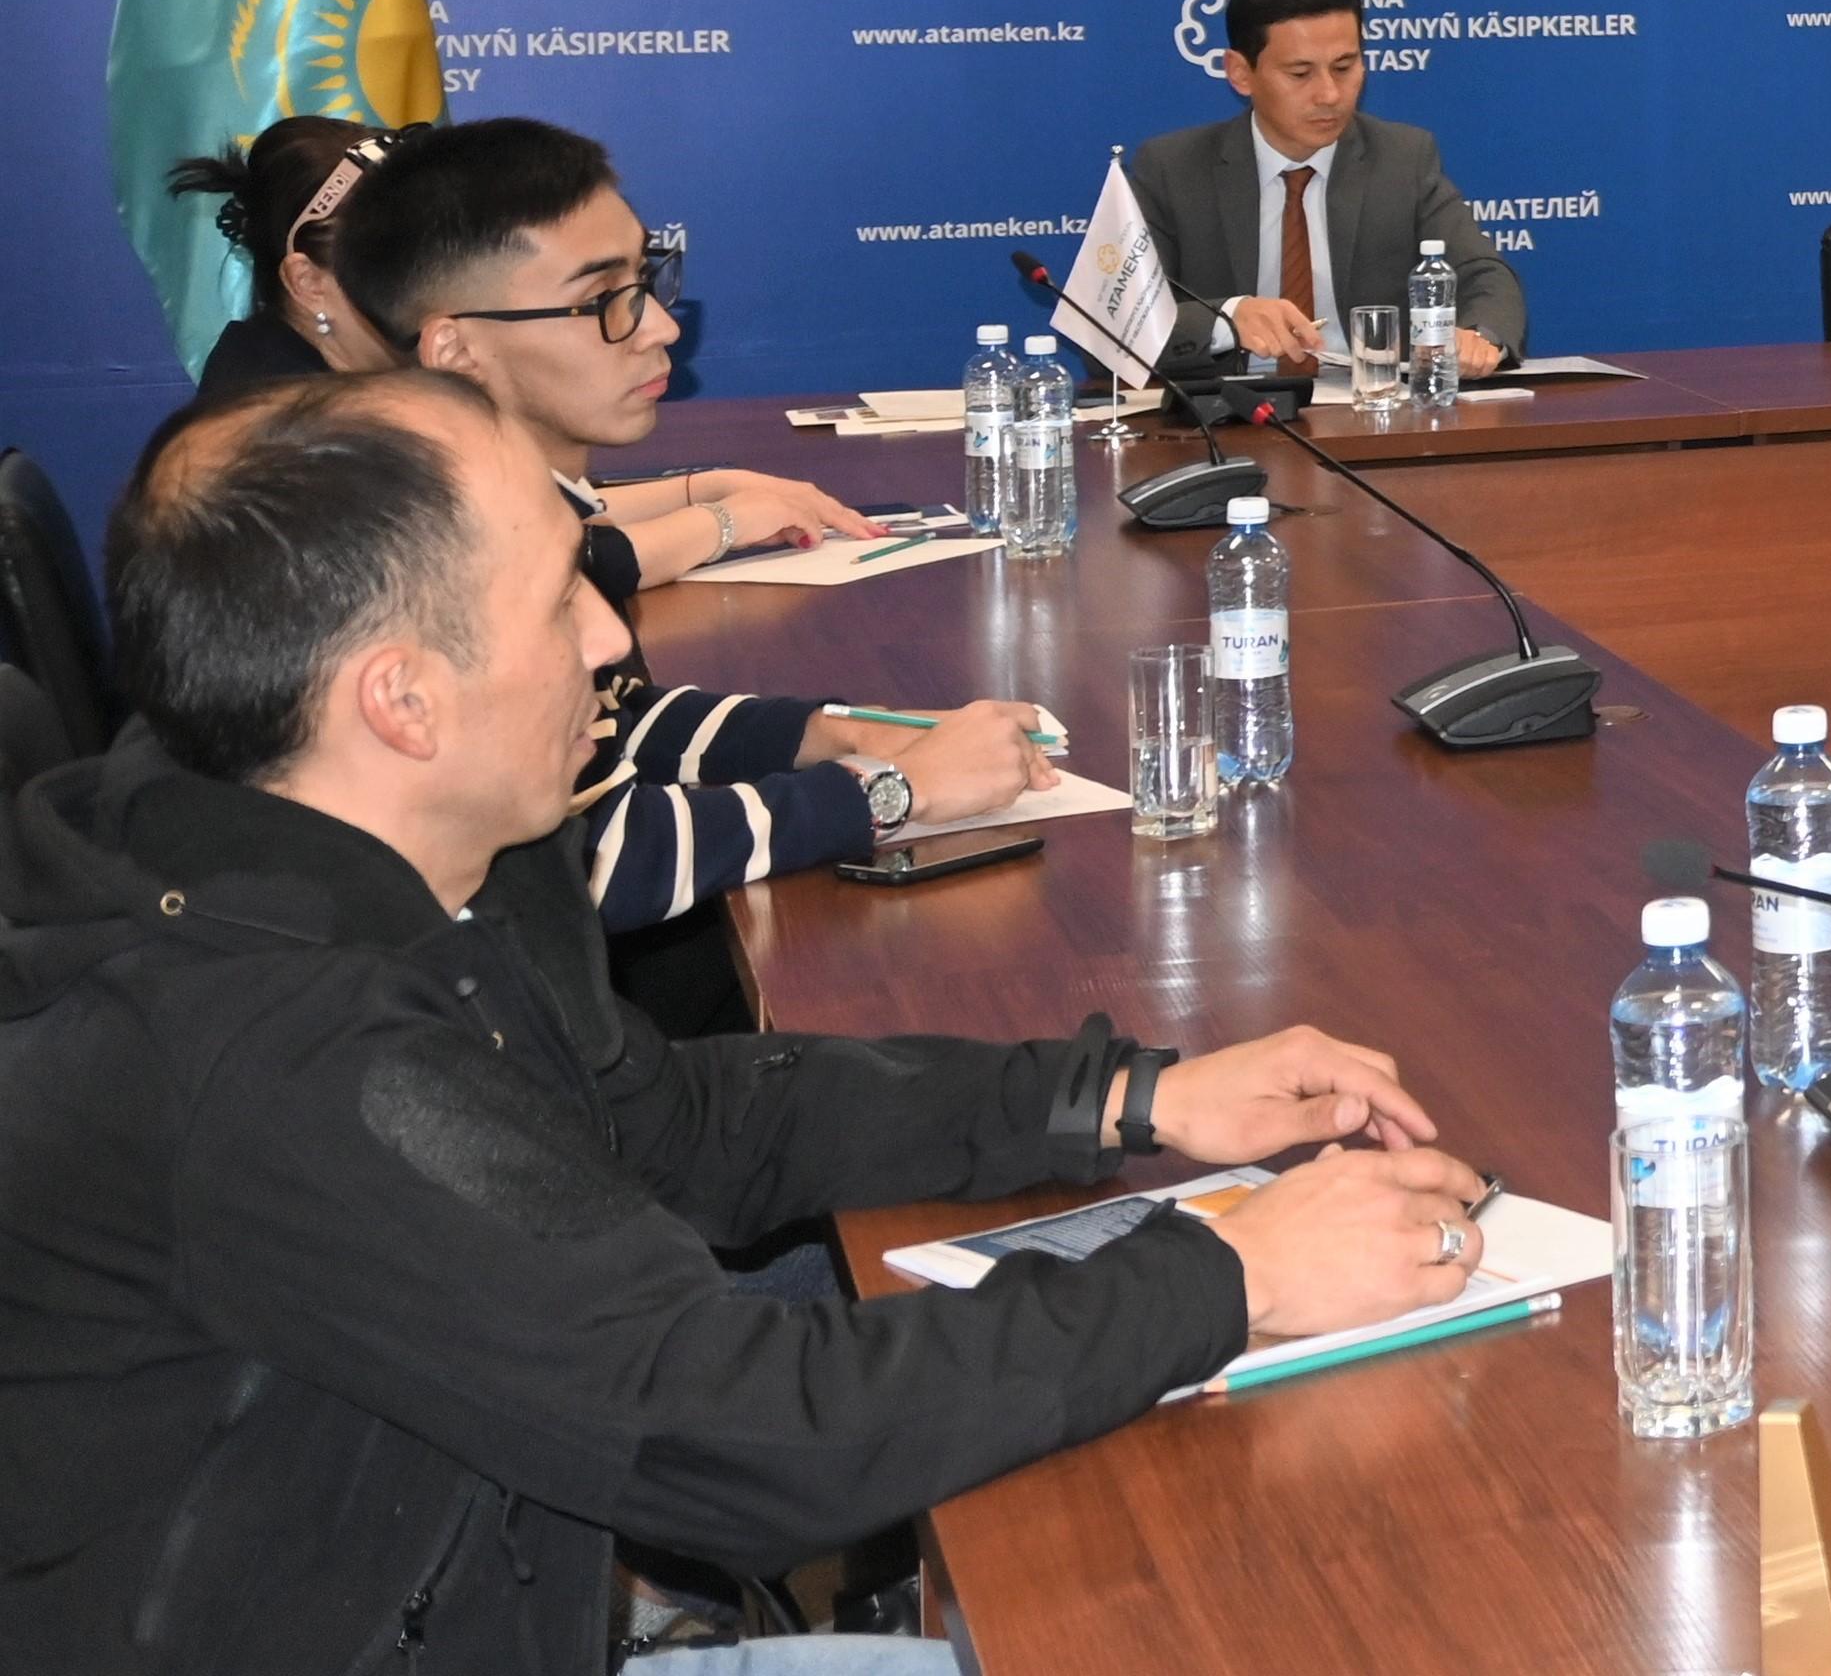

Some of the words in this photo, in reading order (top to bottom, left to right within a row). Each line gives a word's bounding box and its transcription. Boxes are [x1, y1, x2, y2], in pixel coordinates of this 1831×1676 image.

[852, 22, 1084, 44] www.atameken.kz
[1468, 12, 1636, 37] KÄSIPKERLER
[527, 27, 730, 56] KÄSIPKERLER
[856, 215, 1089, 243] www.atameken.kz
[1222, 634, 1278, 649] TURAN
